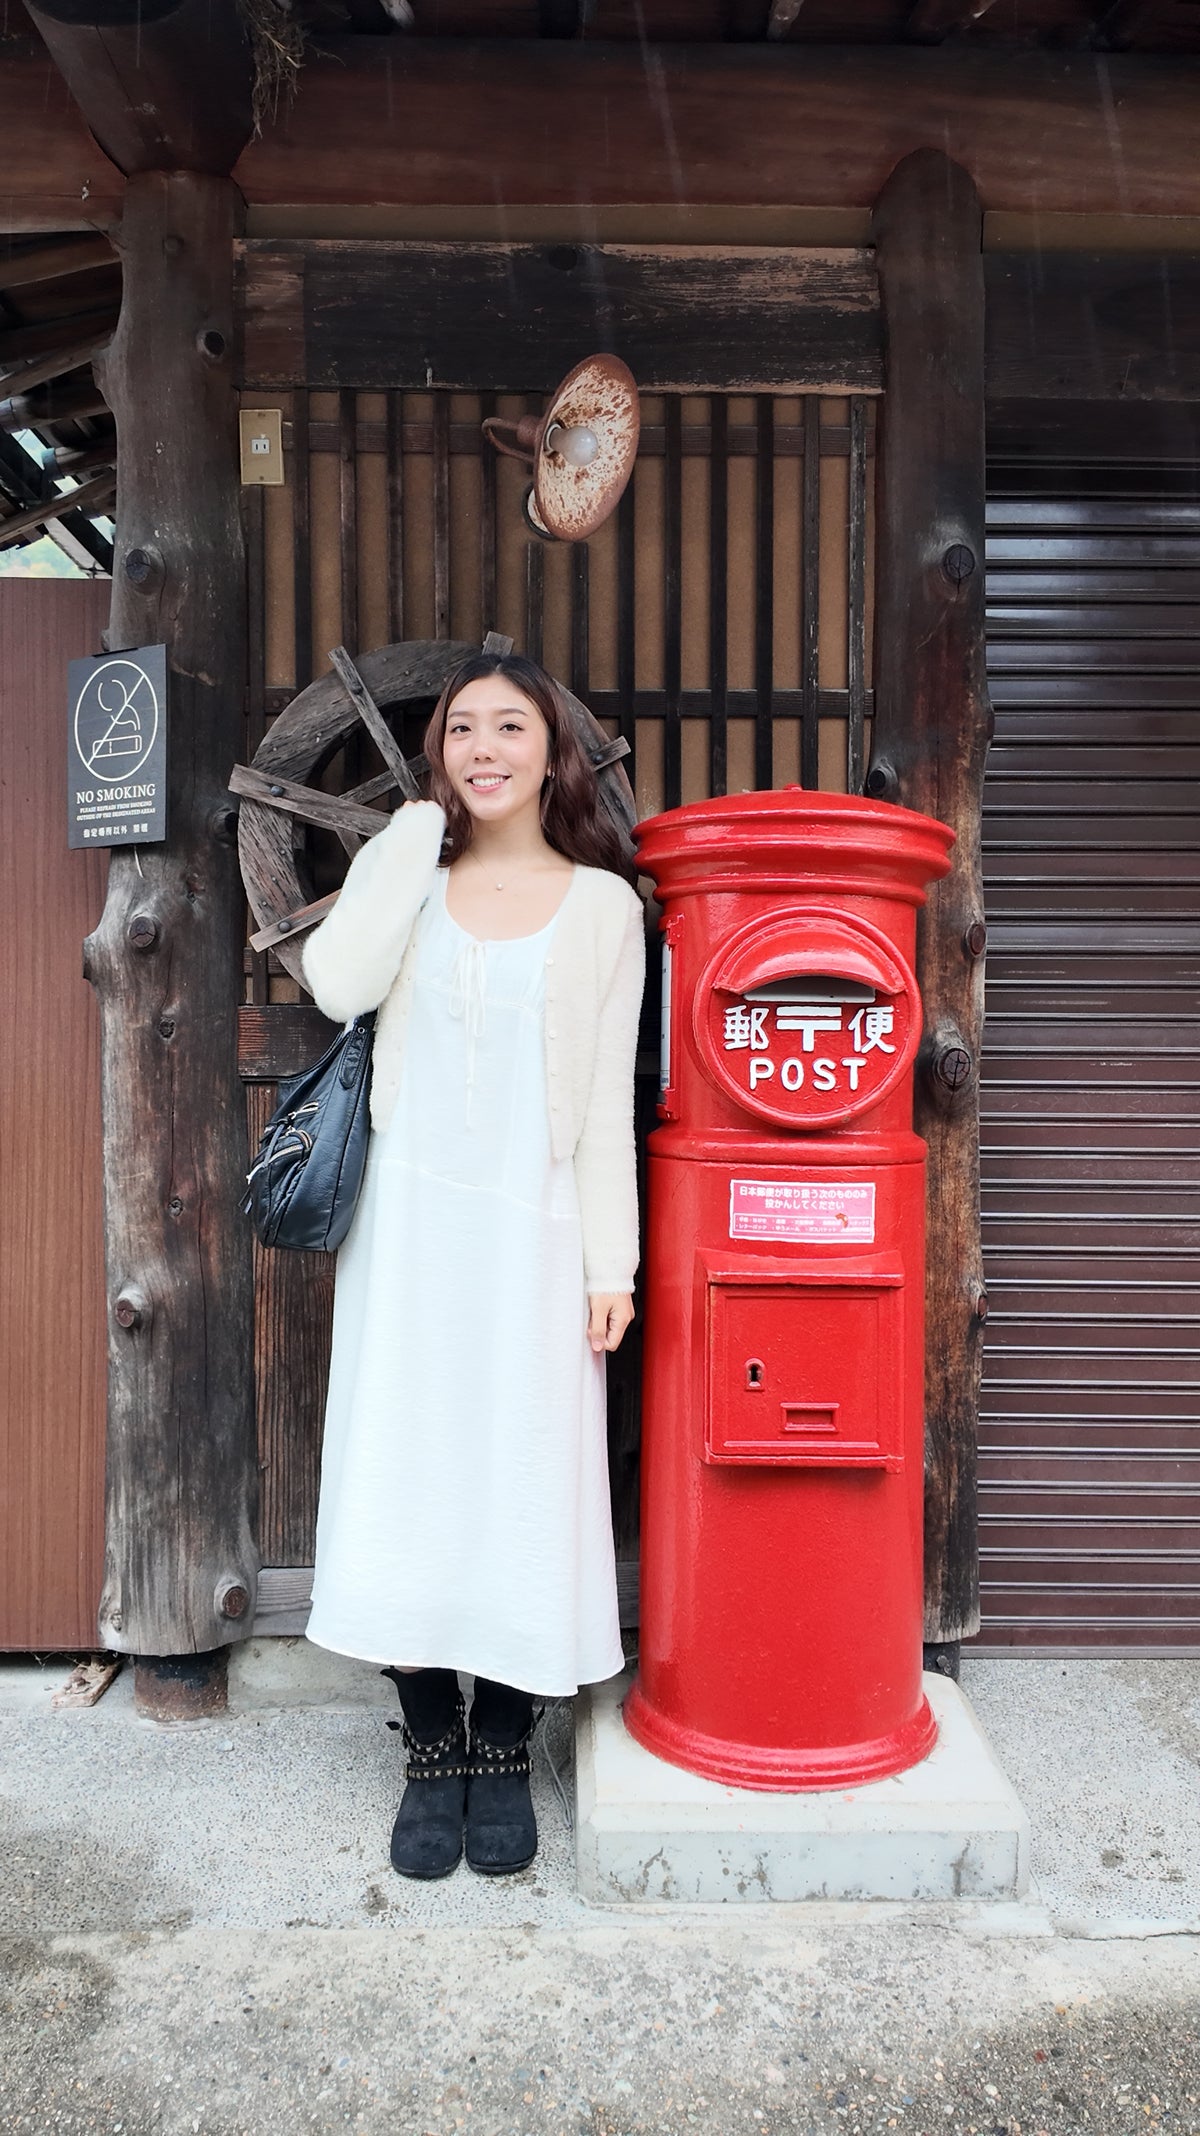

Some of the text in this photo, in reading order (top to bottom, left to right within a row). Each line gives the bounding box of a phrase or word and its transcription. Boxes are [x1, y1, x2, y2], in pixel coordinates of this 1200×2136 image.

[76, 784, 156, 804] NO SMOKING
[750, 1058, 867, 1091] POST
[740, 1186, 868, 1199] 日本郵便が取り扱う次のもののみ
[765, 1199, 844, 1210] 投かんしてください
